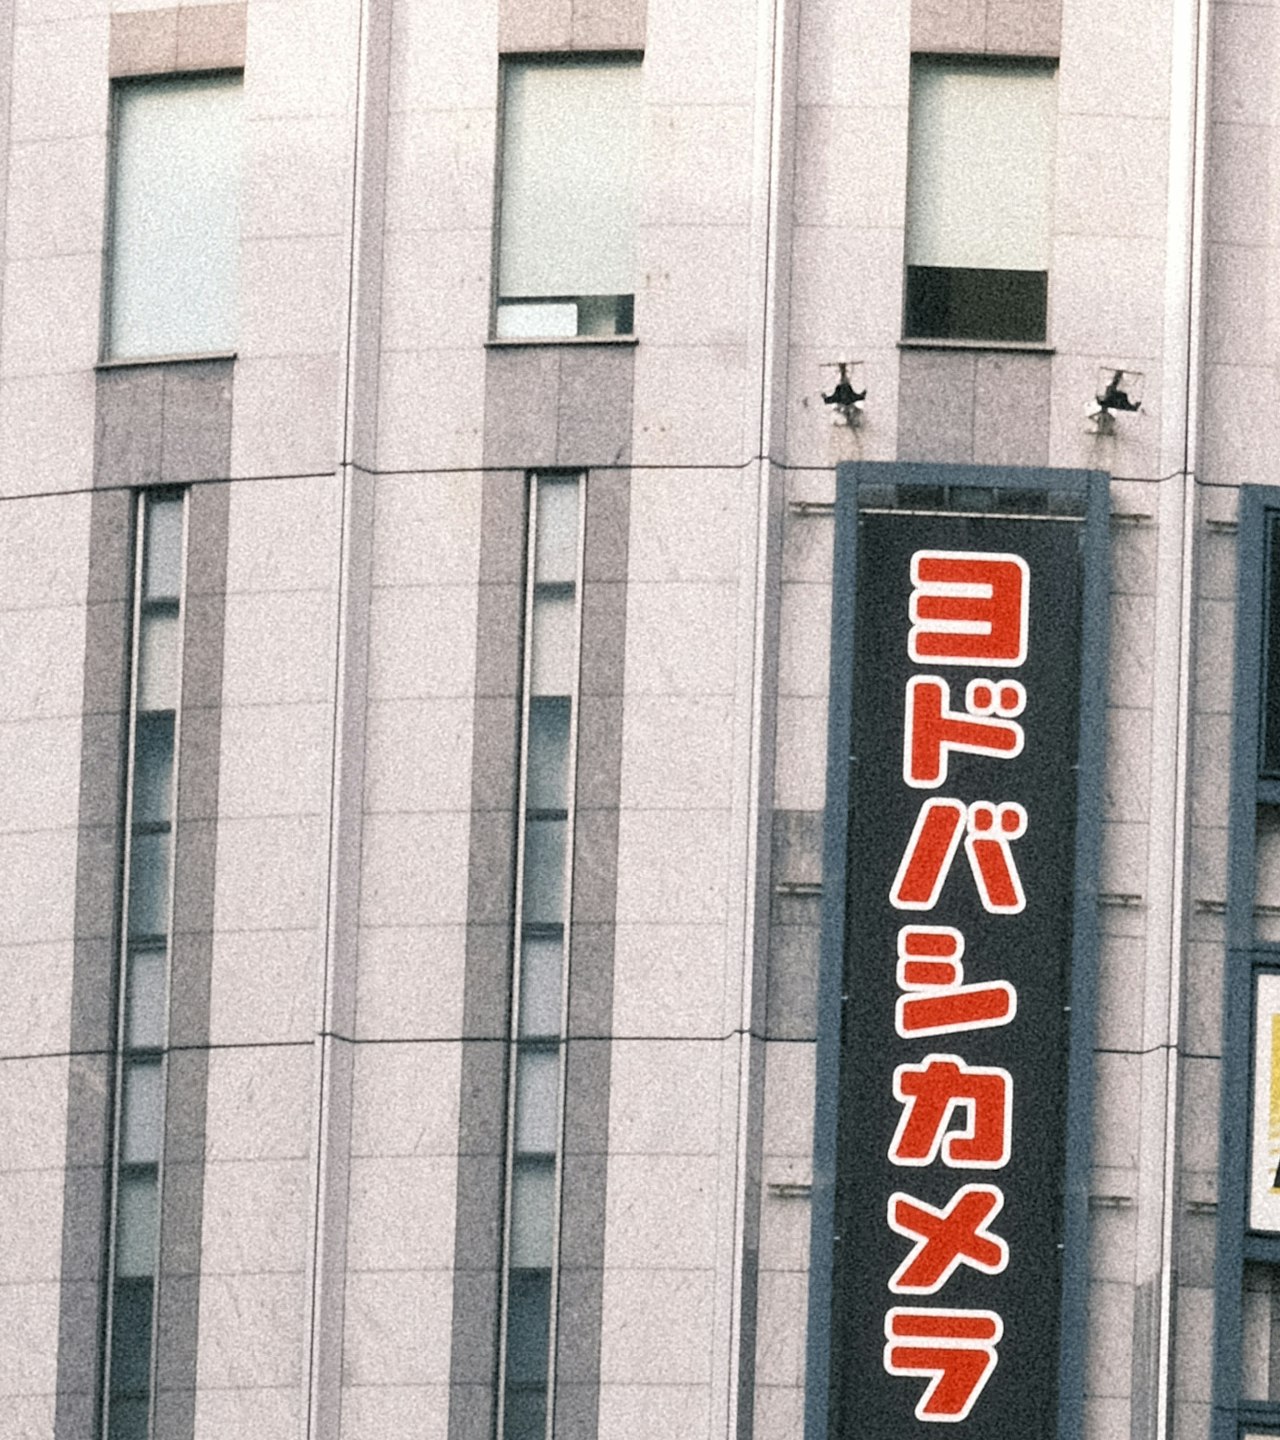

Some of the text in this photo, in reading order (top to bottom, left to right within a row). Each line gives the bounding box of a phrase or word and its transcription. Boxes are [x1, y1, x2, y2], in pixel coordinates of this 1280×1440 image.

[884, 549, 1030, 1423] ヨドバシカメラ
